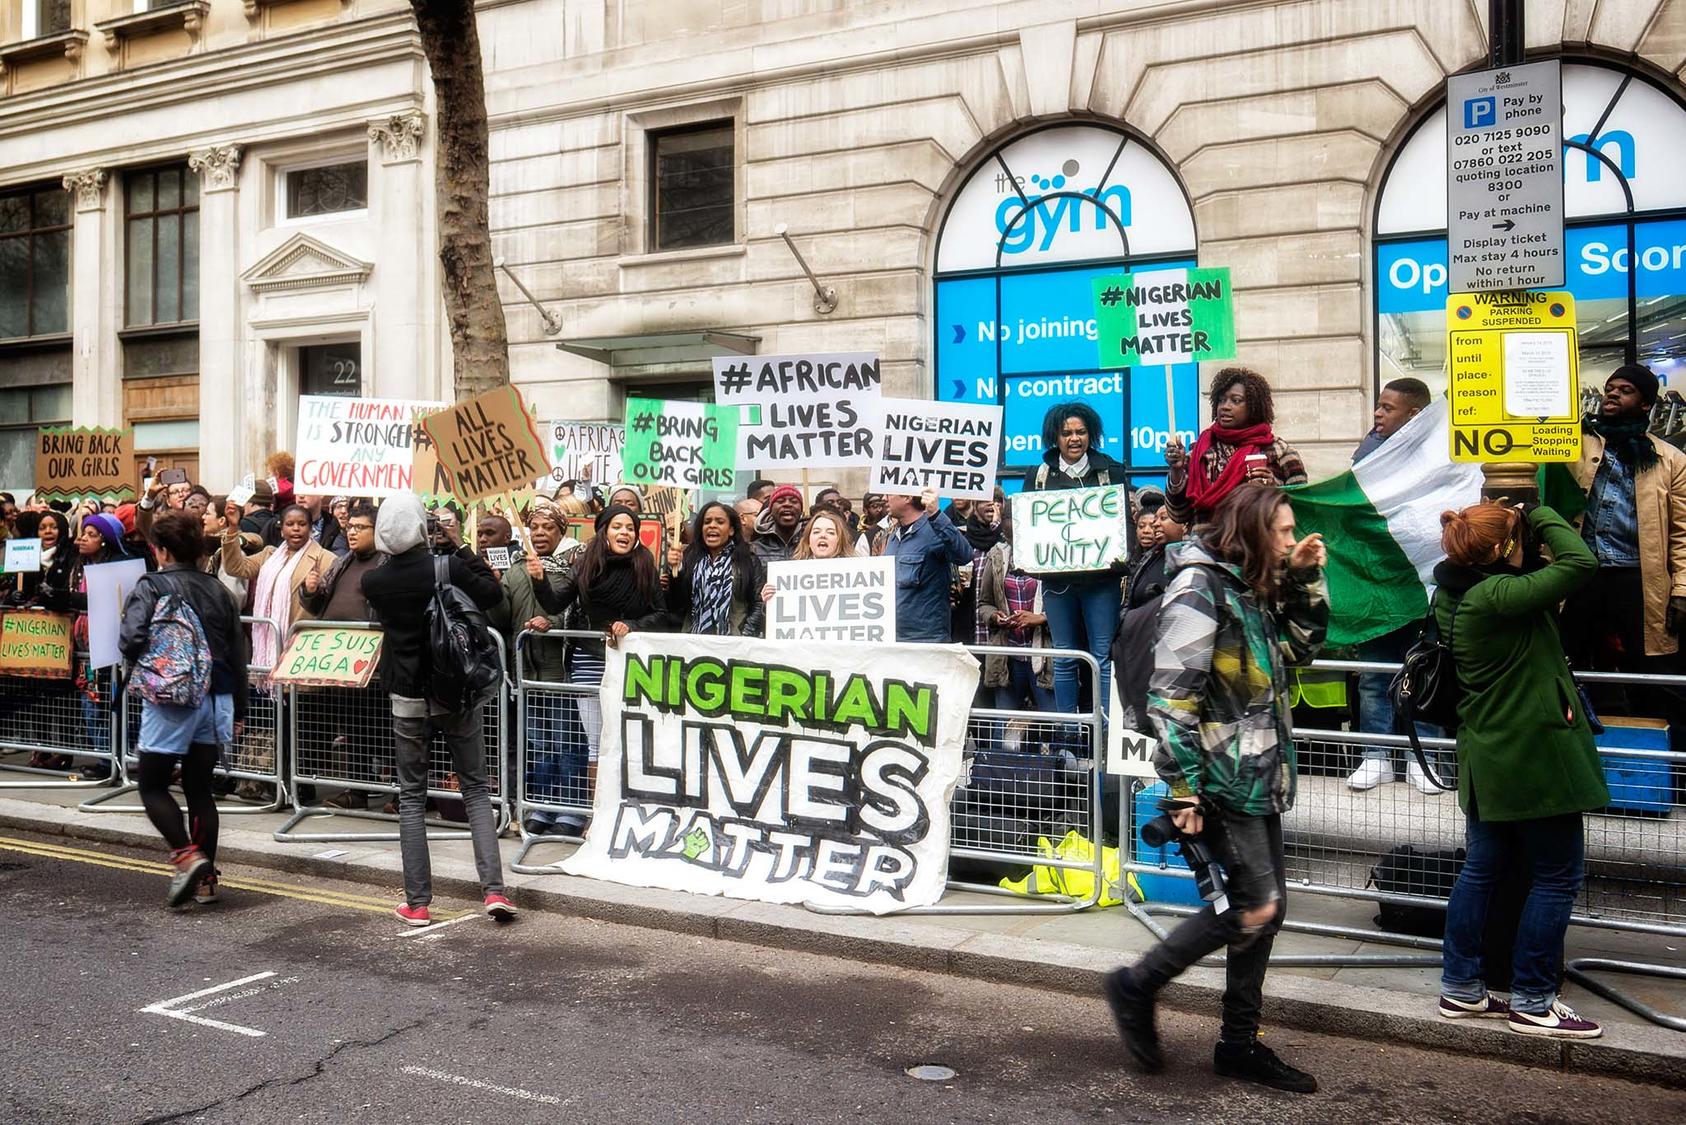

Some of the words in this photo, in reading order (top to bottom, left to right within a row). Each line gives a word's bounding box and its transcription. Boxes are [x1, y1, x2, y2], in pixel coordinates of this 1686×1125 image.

[1503, 97, 1524, 107] Pay
[1529, 94, 1544, 105] by
[1505, 106, 1542, 120] phone
[1455, 134, 1480, 146] 020
[1483, 130, 1511, 142] 7125
[1515, 124, 1550, 138] 9090
[1482, 147, 1494, 155] or
[1498, 142, 1522, 153] text
[1453, 156, 1494, 170] 07860
[1498, 153, 1523, 164] 022
[1526, 149, 1552, 161] 205
[995, 173, 1025, 193] the
[1456, 170, 1500, 183] quoting
[1505, 163, 1554, 176] location
[1487, 180, 1523, 191] 8300
[995, 184, 1132, 254] gym
[1459, 211, 1480, 220] Pay
[1484, 208, 1496, 218] at
[1500, 203, 1551, 216] machine
[1463, 237, 1507, 248] Display
[1511, 232, 1547, 244] ticket
[1453, 254, 1477, 264] Max
[1481, 252, 1506, 262] stay
[1510, 250, 1519, 259] 4
[1523, 248, 1559, 258] hours
[1475, 267, 1492, 276] No
[1497, 264, 1535, 274] return
[1100, 279, 1221, 307] #NIGERIAN
[1466, 278, 1504, 289] within
[1507, 277, 1513, 286] 1
[1517, 276, 1545, 285] hour
[1474, 292, 1547, 305] WARNING
[1139, 309, 1193, 328] LIVES
[1481, 317, 1542, 326] SUSPENDED
[1489, 307, 1533, 316] PARKING
[978, 320, 1011, 342] No
[1017, 315, 1098, 345] joining
[1121, 331, 1211, 355] MATTER
[1456, 336, 1483, 346] from
[1456, 353, 1482, 363] until
[334, 360, 356, 384] 22
[719, 358, 881, 395] #AFRICAN
[1018, 372, 1123, 396] contract
[1457, 388, 1497, 397] reason
[308, 401, 343, 419] THE
[348, 402, 405, 421] HUMAN
[455, 401, 494, 437] ALL
[770, 400, 858, 428] LIVES
[1457, 406, 1477, 416] ref:
[306, 423, 322, 441] IS
[632, 412, 718, 442] #BRING
[885, 413, 992, 437] NIGERIAN
[1532, 425, 1573, 436] Loading
[42, 434, 84, 454] BRING
[88, 434, 121, 454] BACK
[452, 423, 514, 465] LIVES
[566, 426, 619, 453] AFRICA
[747, 427, 874, 460] MATTER
[1454, 428, 1513, 456] NO
[1532, 436, 1579, 447] Stopping
[350, 448, 386, 463] ANY
[649, 441, 706, 466] BACK
[882, 434, 989, 468] LIVES
[1532, 447, 1571, 458] Waiting
[48, 457, 77, 478] OUR
[81, 457, 119, 477] GIRLS
[457, 449, 535, 498] MATTER
[633, 463, 677, 484] OUR
[683, 467, 733, 487] GIRLS
[879, 466, 985, 491] MATTER
[1032, 491, 1118, 527] PEACE
[1036, 536, 1110, 566] UNITY
[776, 571, 885, 591] NIGERIAN
[775, 592, 885, 622] LIVES
[5, 618, 66, 636] #NIGERIAN
[775, 625, 885, 642] MATTER
[2, 642, 29, 657] LIVES
[32, 643, 66, 659] MATTER
[296, 634, 325, 652] JE
[330, 632, 379, 654] SUIS
[289, 654, 348, 675] BAGA
[622, 653, 938, 747] NIGERIAN
[621, 712, 930, 845] LIVES
[608, 802, 918, 901] MATTER
